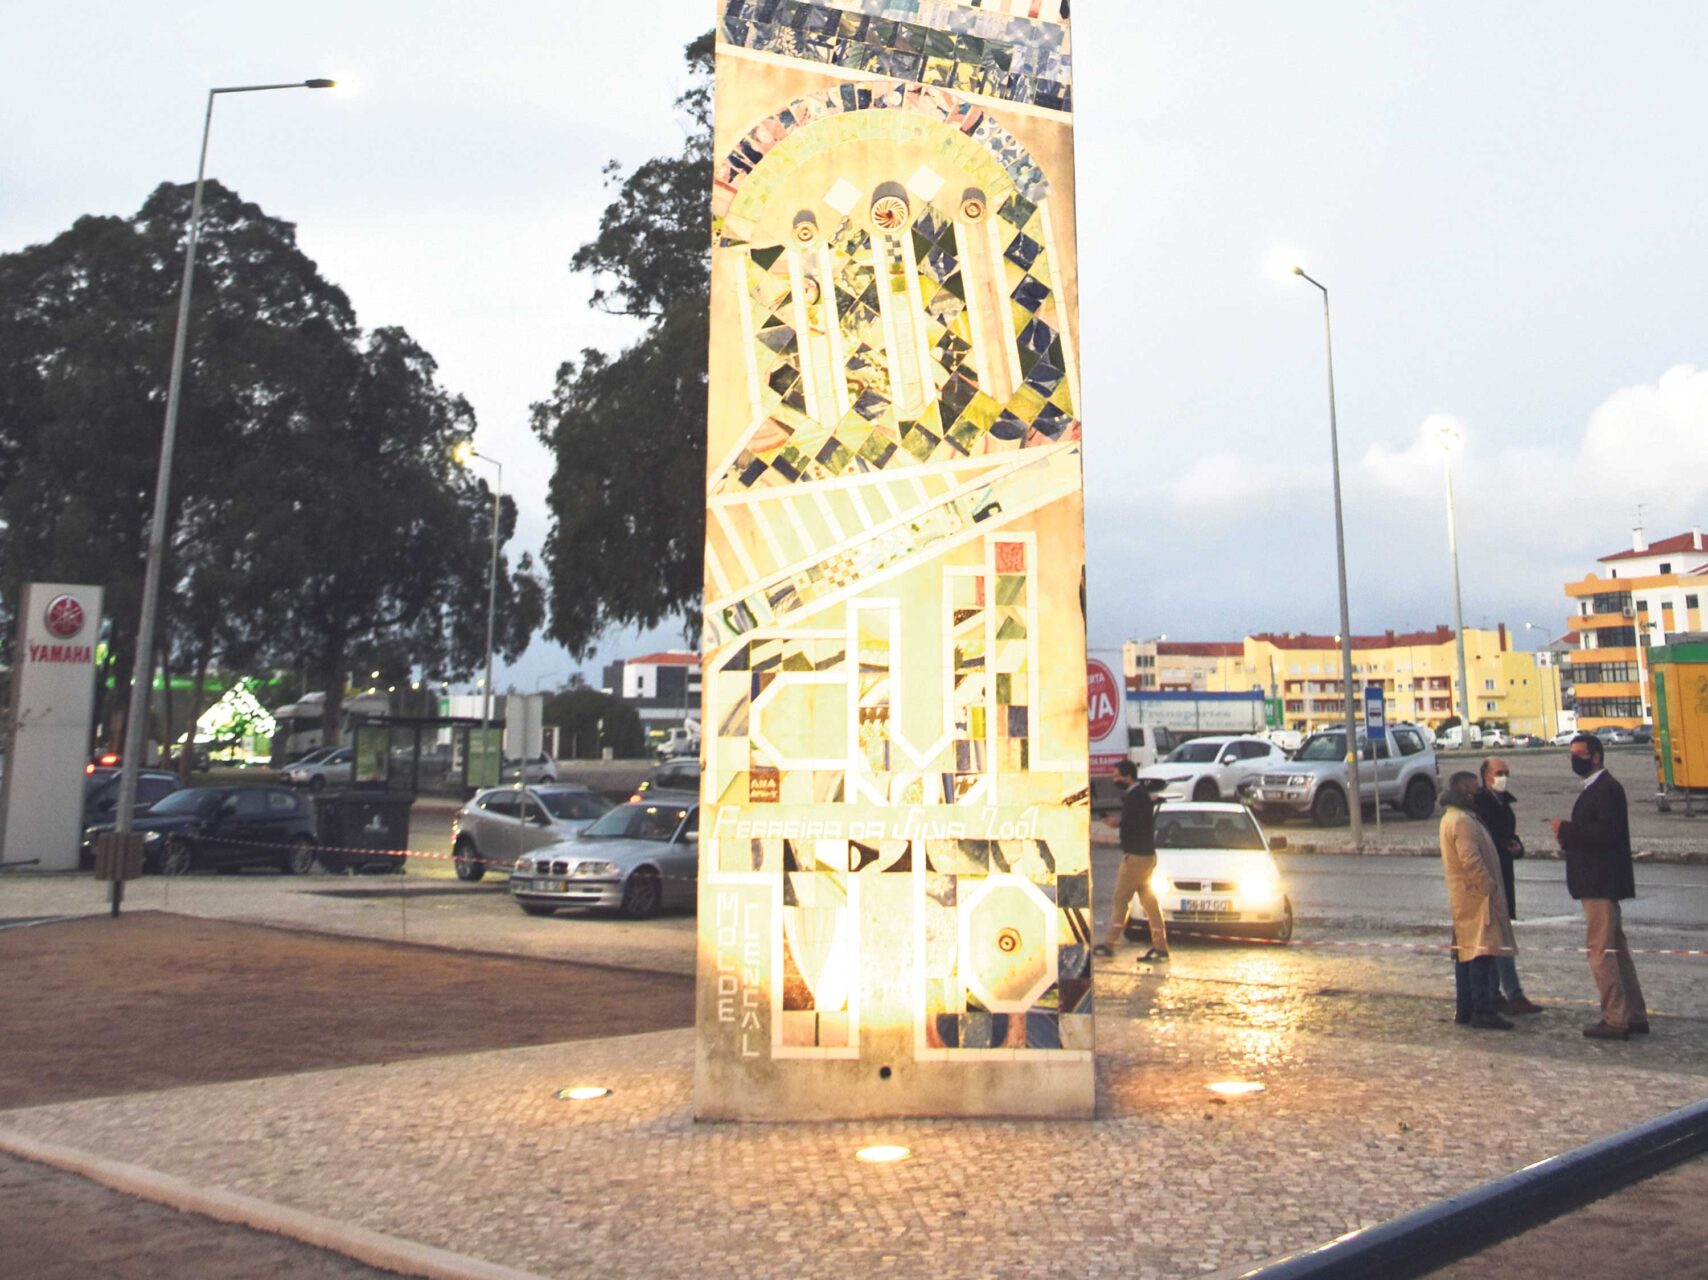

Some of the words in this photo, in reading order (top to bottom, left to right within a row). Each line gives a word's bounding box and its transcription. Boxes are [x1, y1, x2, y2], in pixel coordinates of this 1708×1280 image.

[31, 645, 91, 663] YAMAHA
[1087, 673, 1105, 684] ERTA
[717, 891, 739, 1022] MOLDE
